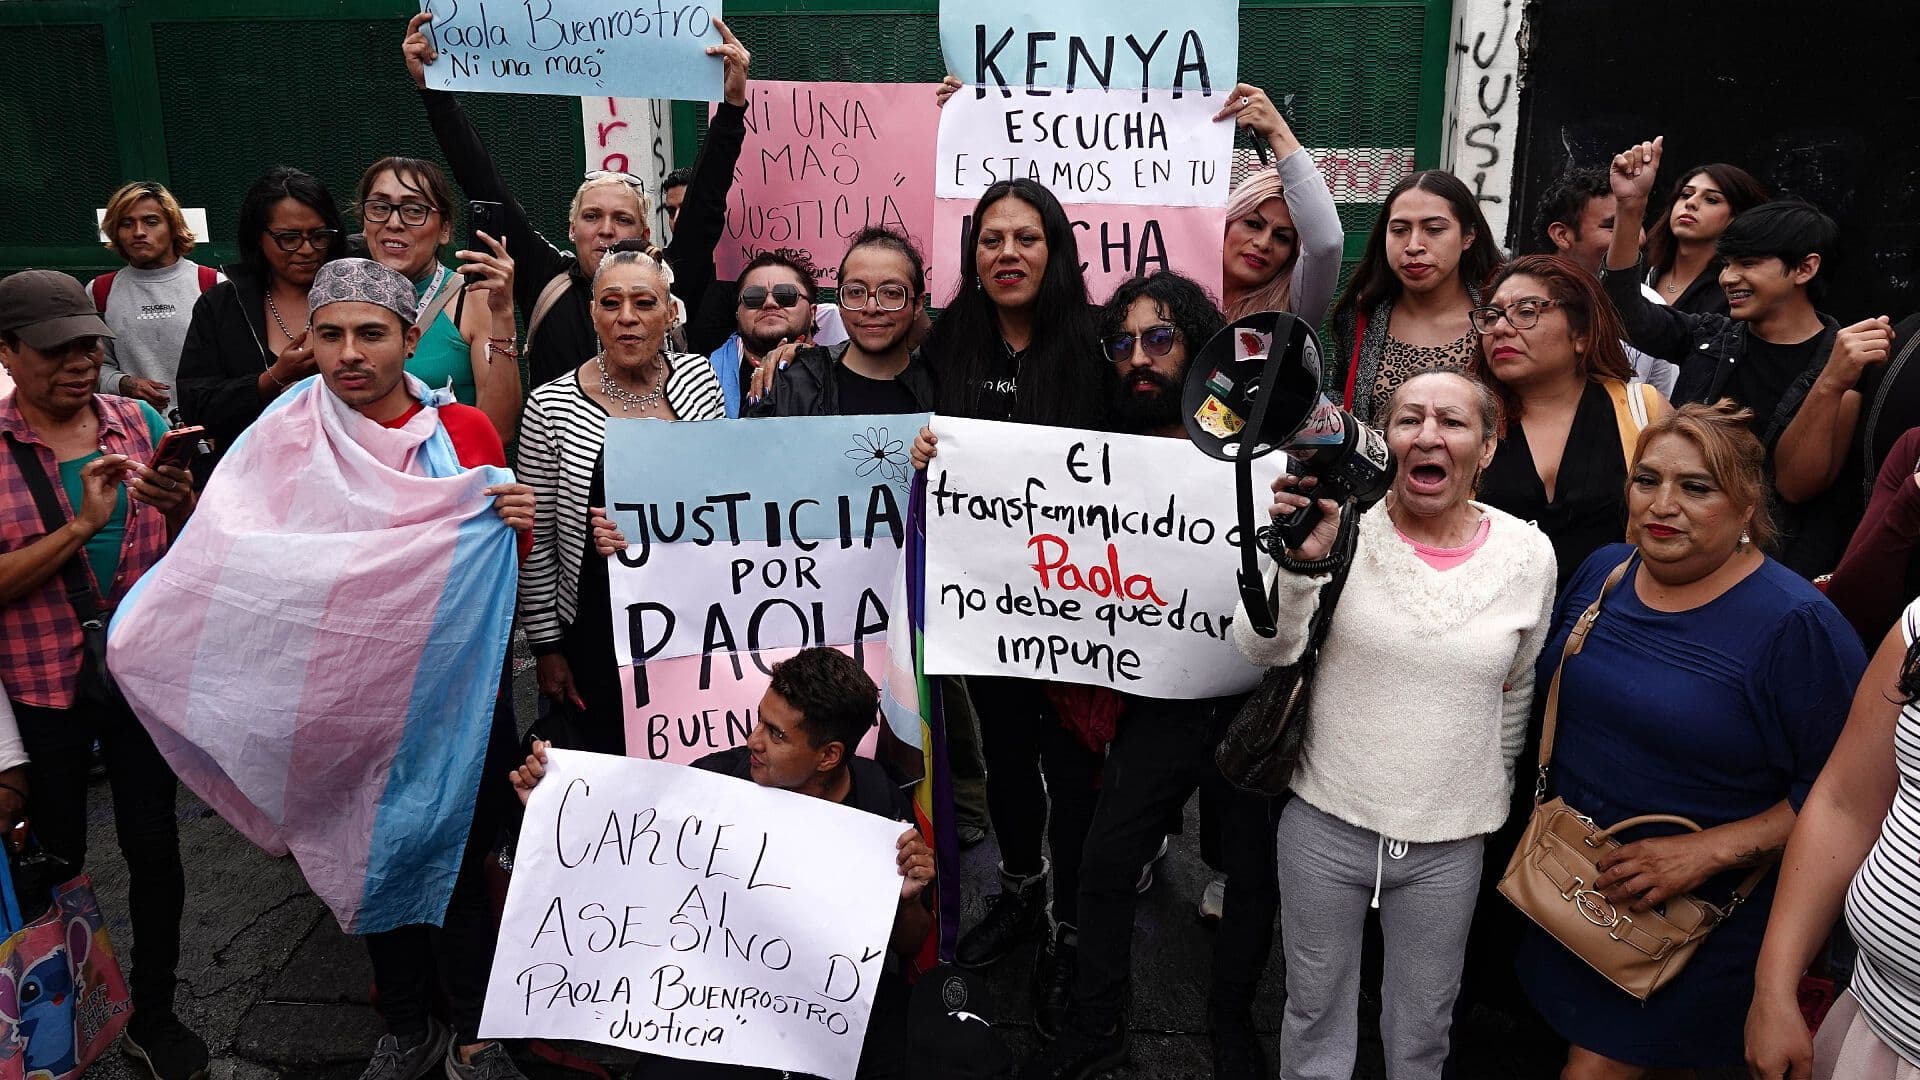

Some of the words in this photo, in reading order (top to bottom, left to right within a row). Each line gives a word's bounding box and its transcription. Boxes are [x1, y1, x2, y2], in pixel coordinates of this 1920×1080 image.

[428, 0, 510, 53] Paola
[523, 0, 710, 52] Buenrostro
[492, 56, 532, 77] una
[975, 24, 1212, 103] KENYA
[792, 87, 877, 140] UNA
[1005, 109, 1168, 151] ESCUCHA
[761, 142, 860, 186] MAS
[954, 153, 1112, 193] ESTAMOS
[1134, 158, 1171, 188] EN
[1188, 159, 1216, 186] TU
[614, 484, 904, 568] JUSTICIA
[931, 470, 1215, 545] transfeminicidio
[731, 556, 821, 595] POR
[1027, 533, 1168, 607] Paola
[941, 583, 986, 619] no
[995, 583, 1084, 622] debe
[1095, 588, 1235, 641] quedar
[555, 778, 792, 890] CARCEL
[530, 896, 793, 971] ASESINO
[516, 962, 632, 1017] PAOLA
[650, 963, 849, 1036] BUENROSTRO
